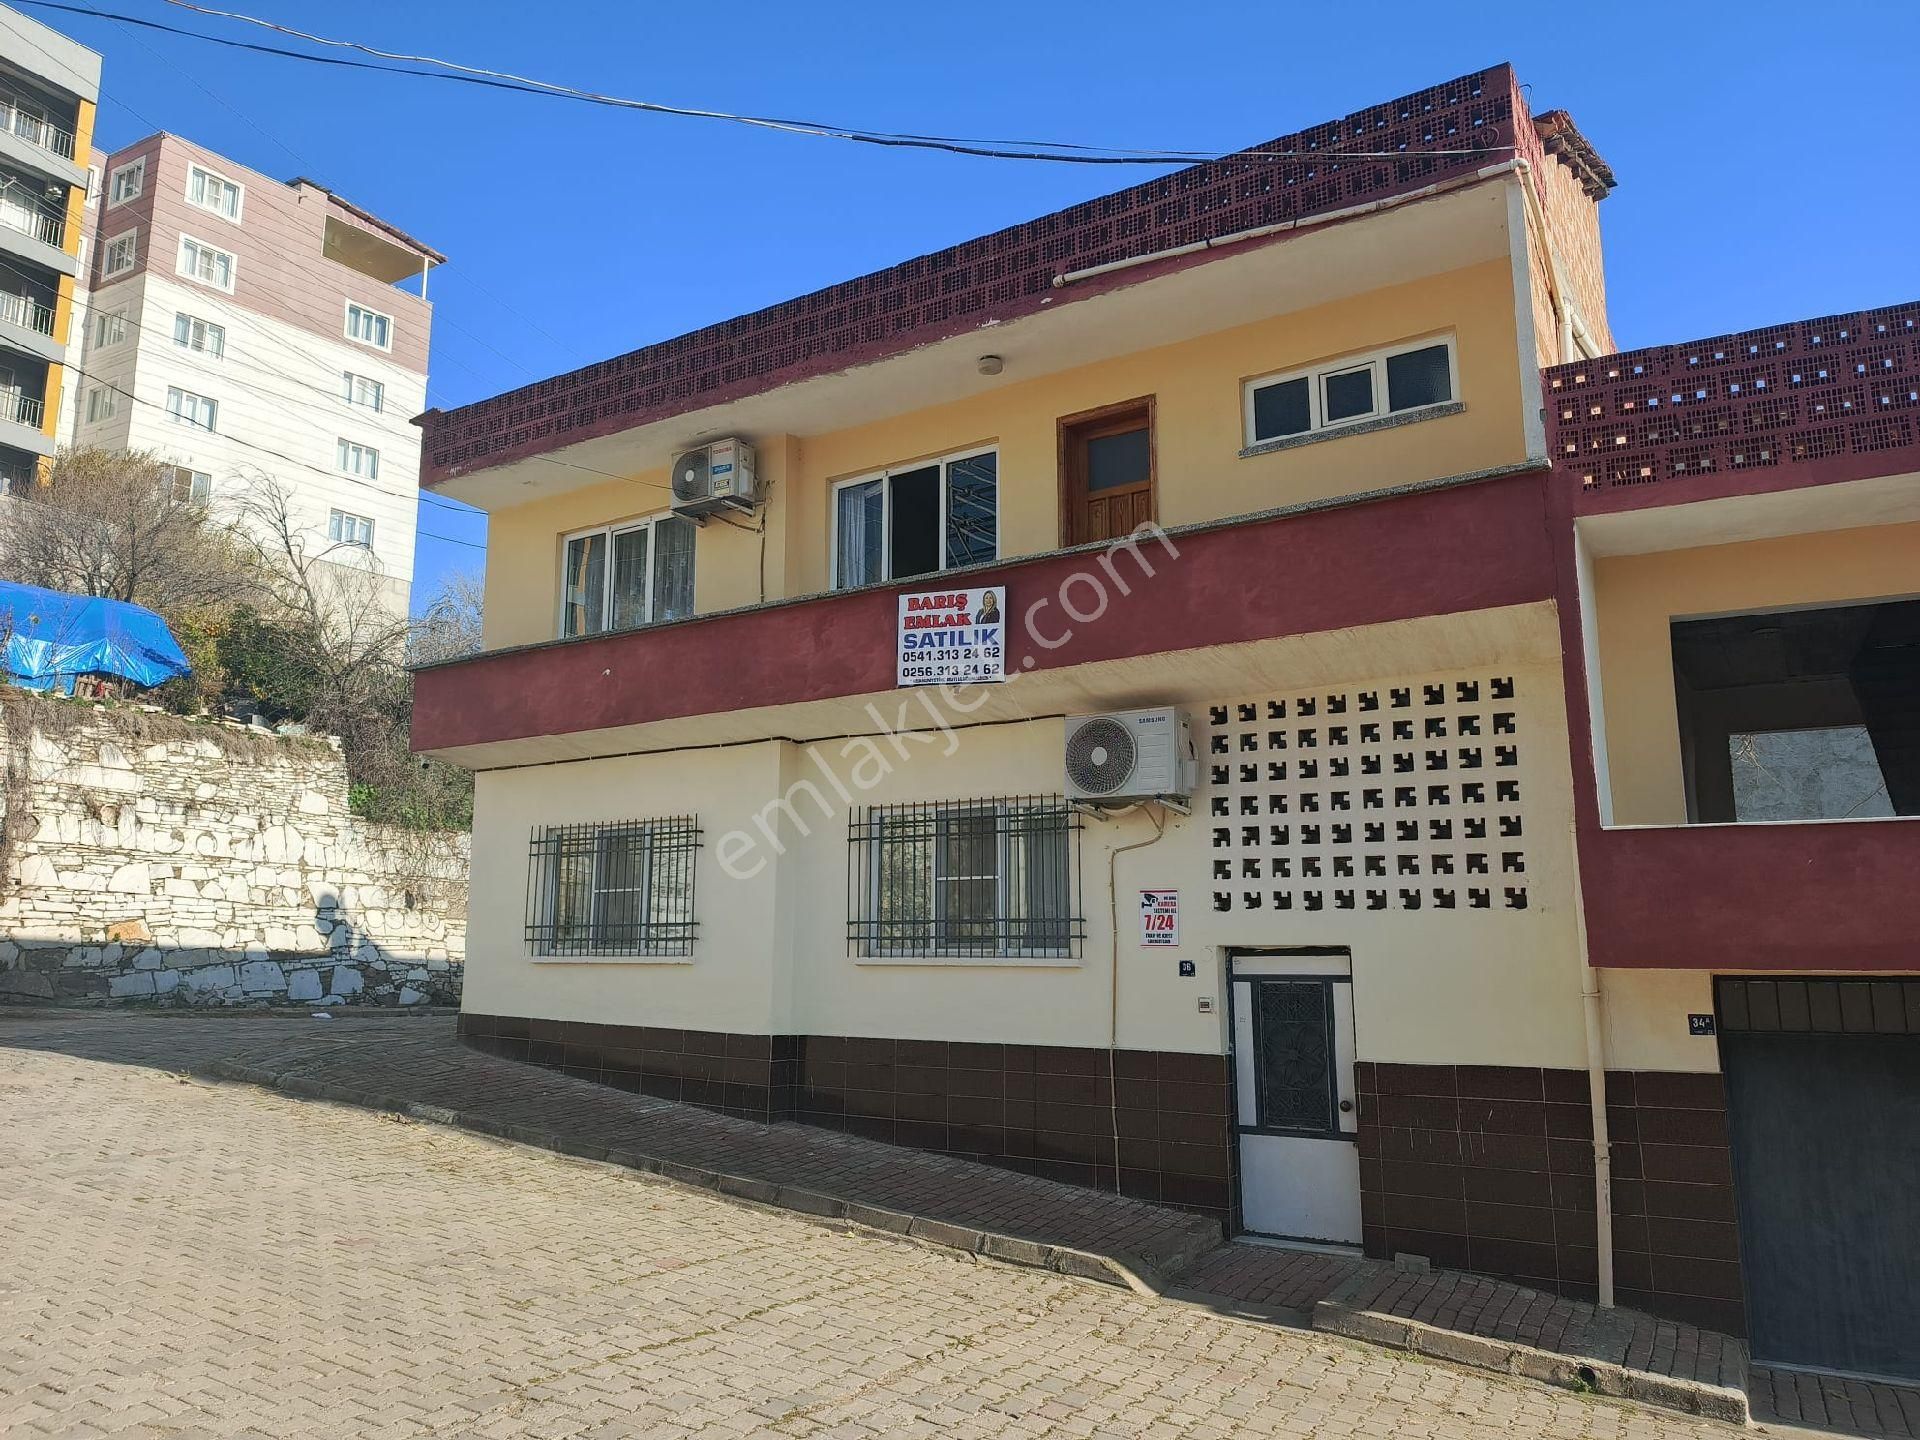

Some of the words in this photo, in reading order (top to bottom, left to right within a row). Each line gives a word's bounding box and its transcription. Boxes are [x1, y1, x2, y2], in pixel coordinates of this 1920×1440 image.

[908, 594, 968, 611] BARIŞ
[904, 613, 972, 629] EMLAK
[903, 628, 999, 649] SATILIK
[903, 650, 959, 662] 0541.313
[964, 649, 979, 659] 24
[984, 647, 1000, 658] 62
[903, 666, 959, 677] 0256.313
[964, 665, 979, 675] 24
[984, 664, 1000, 674] 62
[1144, 915, 1174, 930] 7/24
